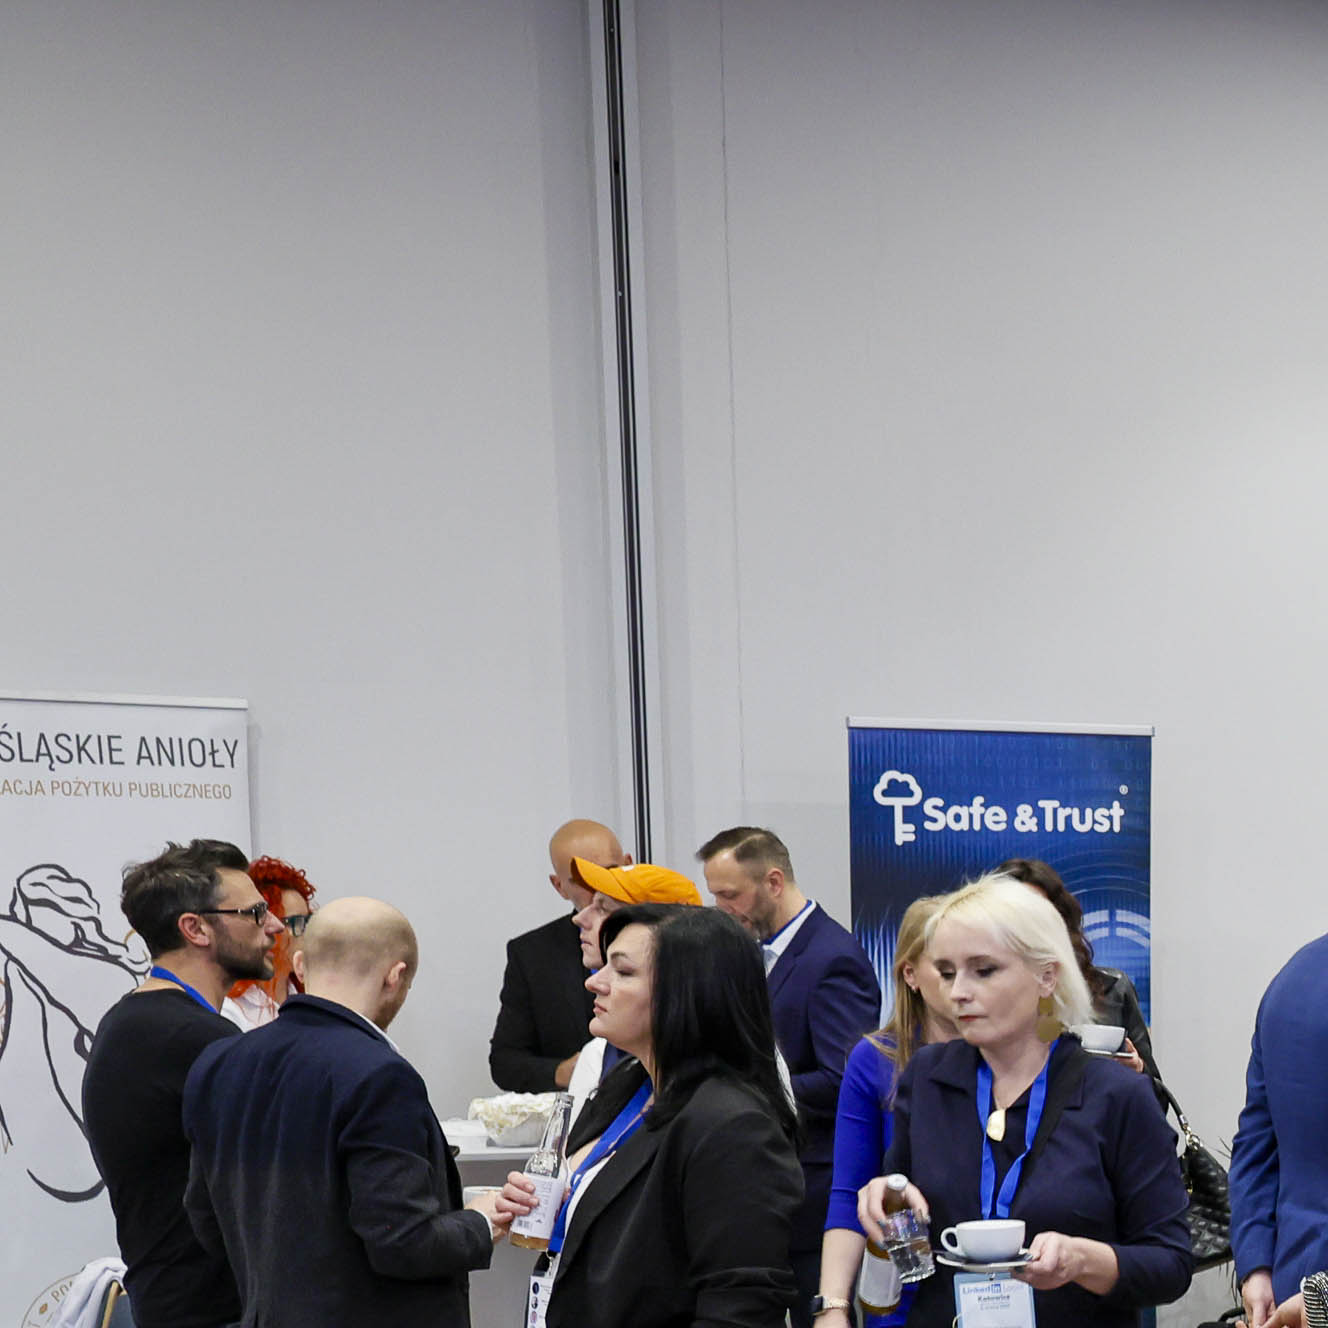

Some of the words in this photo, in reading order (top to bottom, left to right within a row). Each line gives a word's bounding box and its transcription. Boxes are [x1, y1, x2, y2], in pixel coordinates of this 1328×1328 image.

[0, 723, 125, 771] ŚLĄSKIE
[136, 736, 239, 769] ANIOŁY
[0, 779, 46, 796] ACJA
[51, 777, 123, 797] POŻYTKU
[129, 783, 232, 800] PUBLICZNEGO
[923, 796, 1007, 832] Safe
[1038, 800, 1124, 833] Trust
